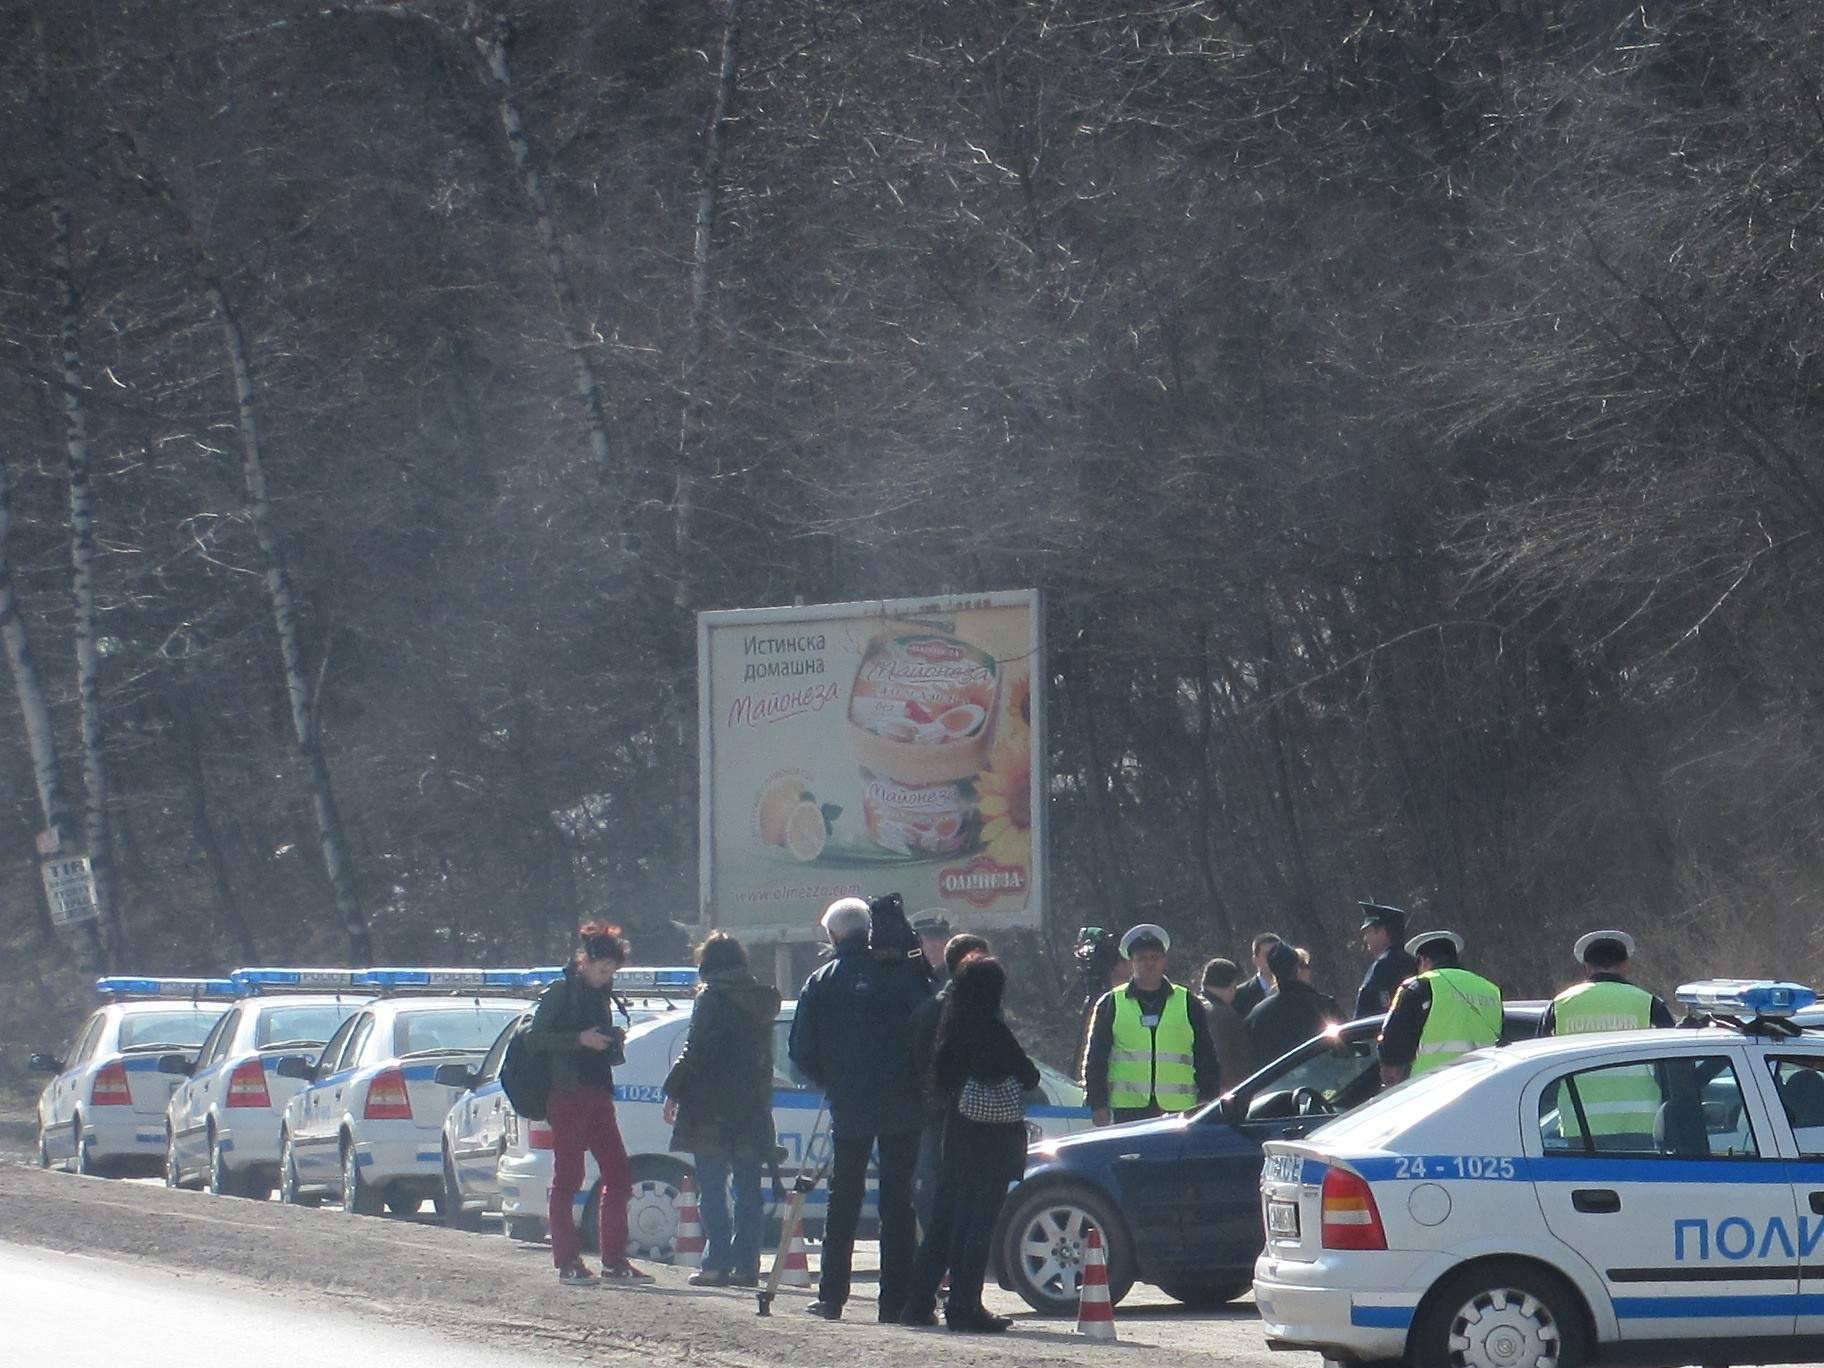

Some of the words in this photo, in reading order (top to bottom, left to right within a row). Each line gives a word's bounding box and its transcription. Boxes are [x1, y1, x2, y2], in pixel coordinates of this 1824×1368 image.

[744, 634, 826, 656] Истинска
[743, 658, 825, 682] домашна
[728, 682, 840, 728] Майонеза
[620, 1086, 663, 1101] 1024
[1394, 1157, 1427, 1178] 24
[1453, 1157, 1515, 1178] 1025
